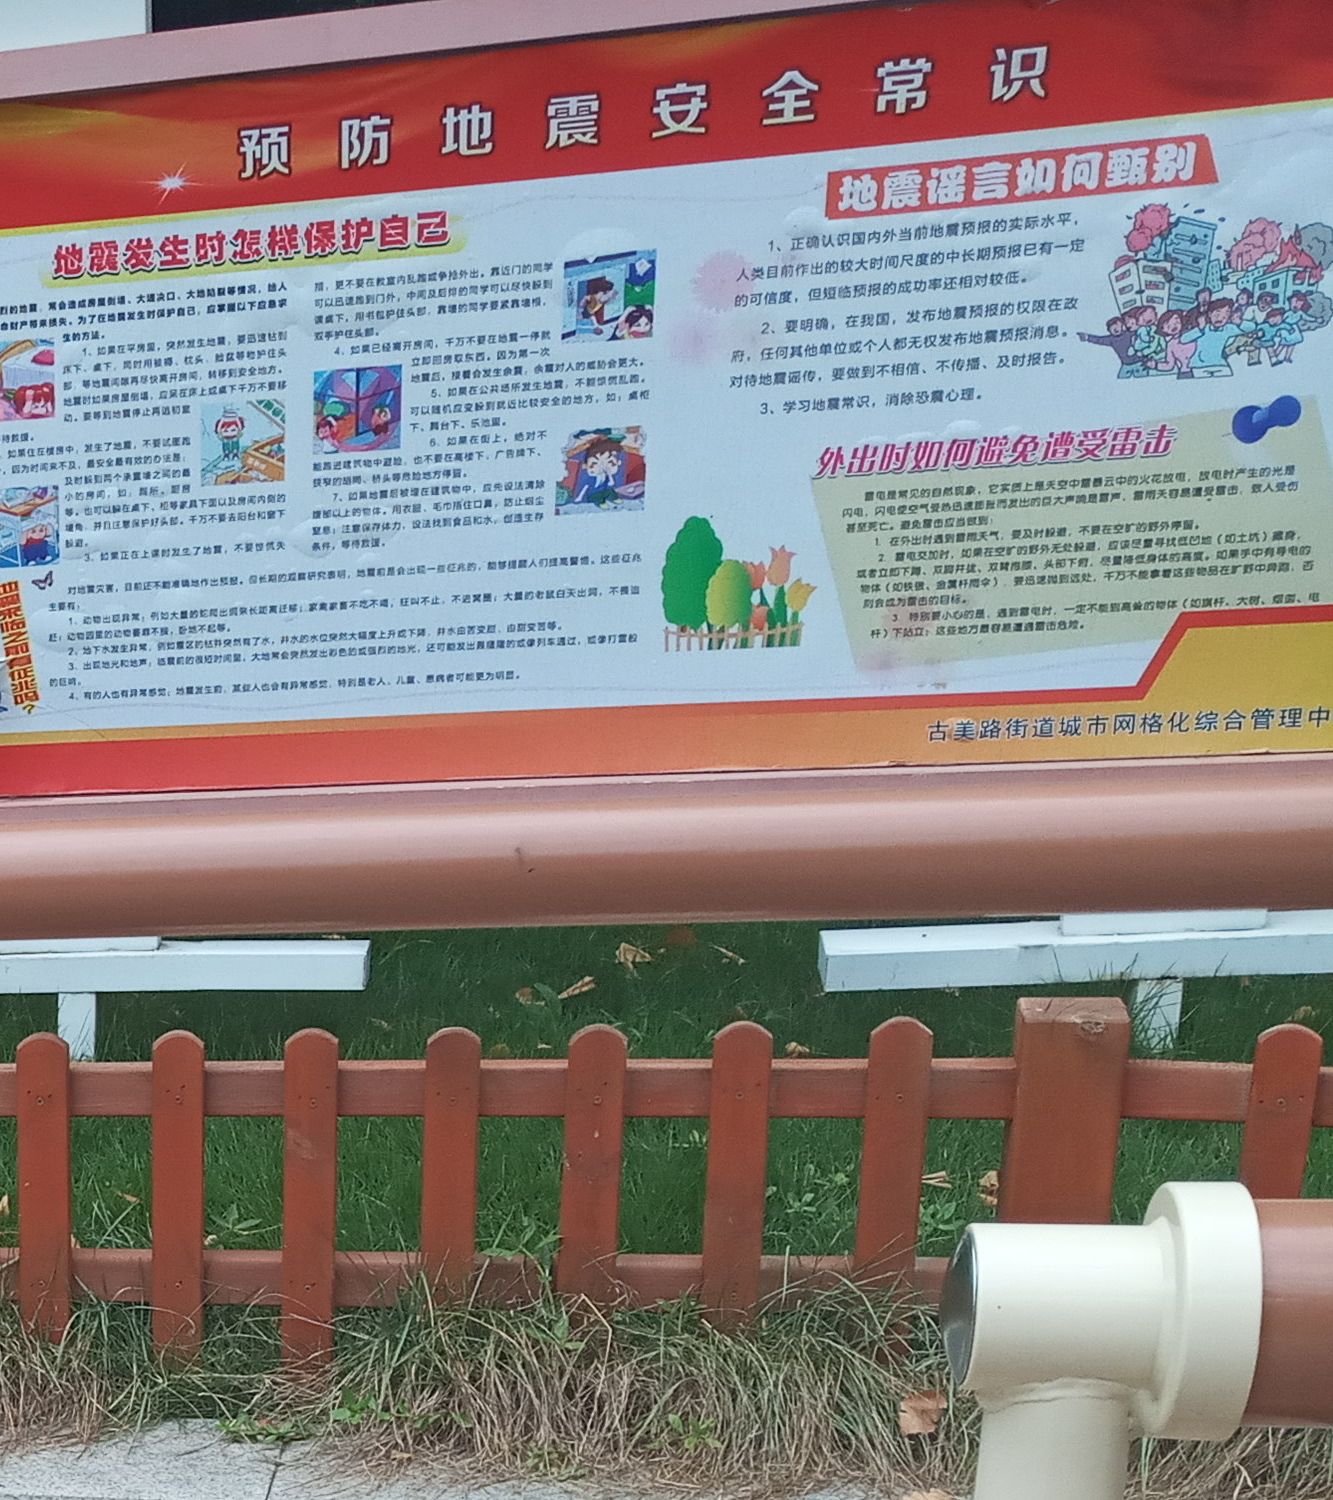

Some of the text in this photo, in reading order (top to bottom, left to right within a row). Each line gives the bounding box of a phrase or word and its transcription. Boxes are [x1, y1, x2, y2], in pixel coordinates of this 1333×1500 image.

[239, 46, 1049, 179] 预防地震安全常识
[838, 142, 1196, 212] 地震谣言如何甄别
[52, 211, 451, 276] 地震发生时怎样保护自己
[816, 424, 1179, 477] 外出时如何避免遭受雷击
